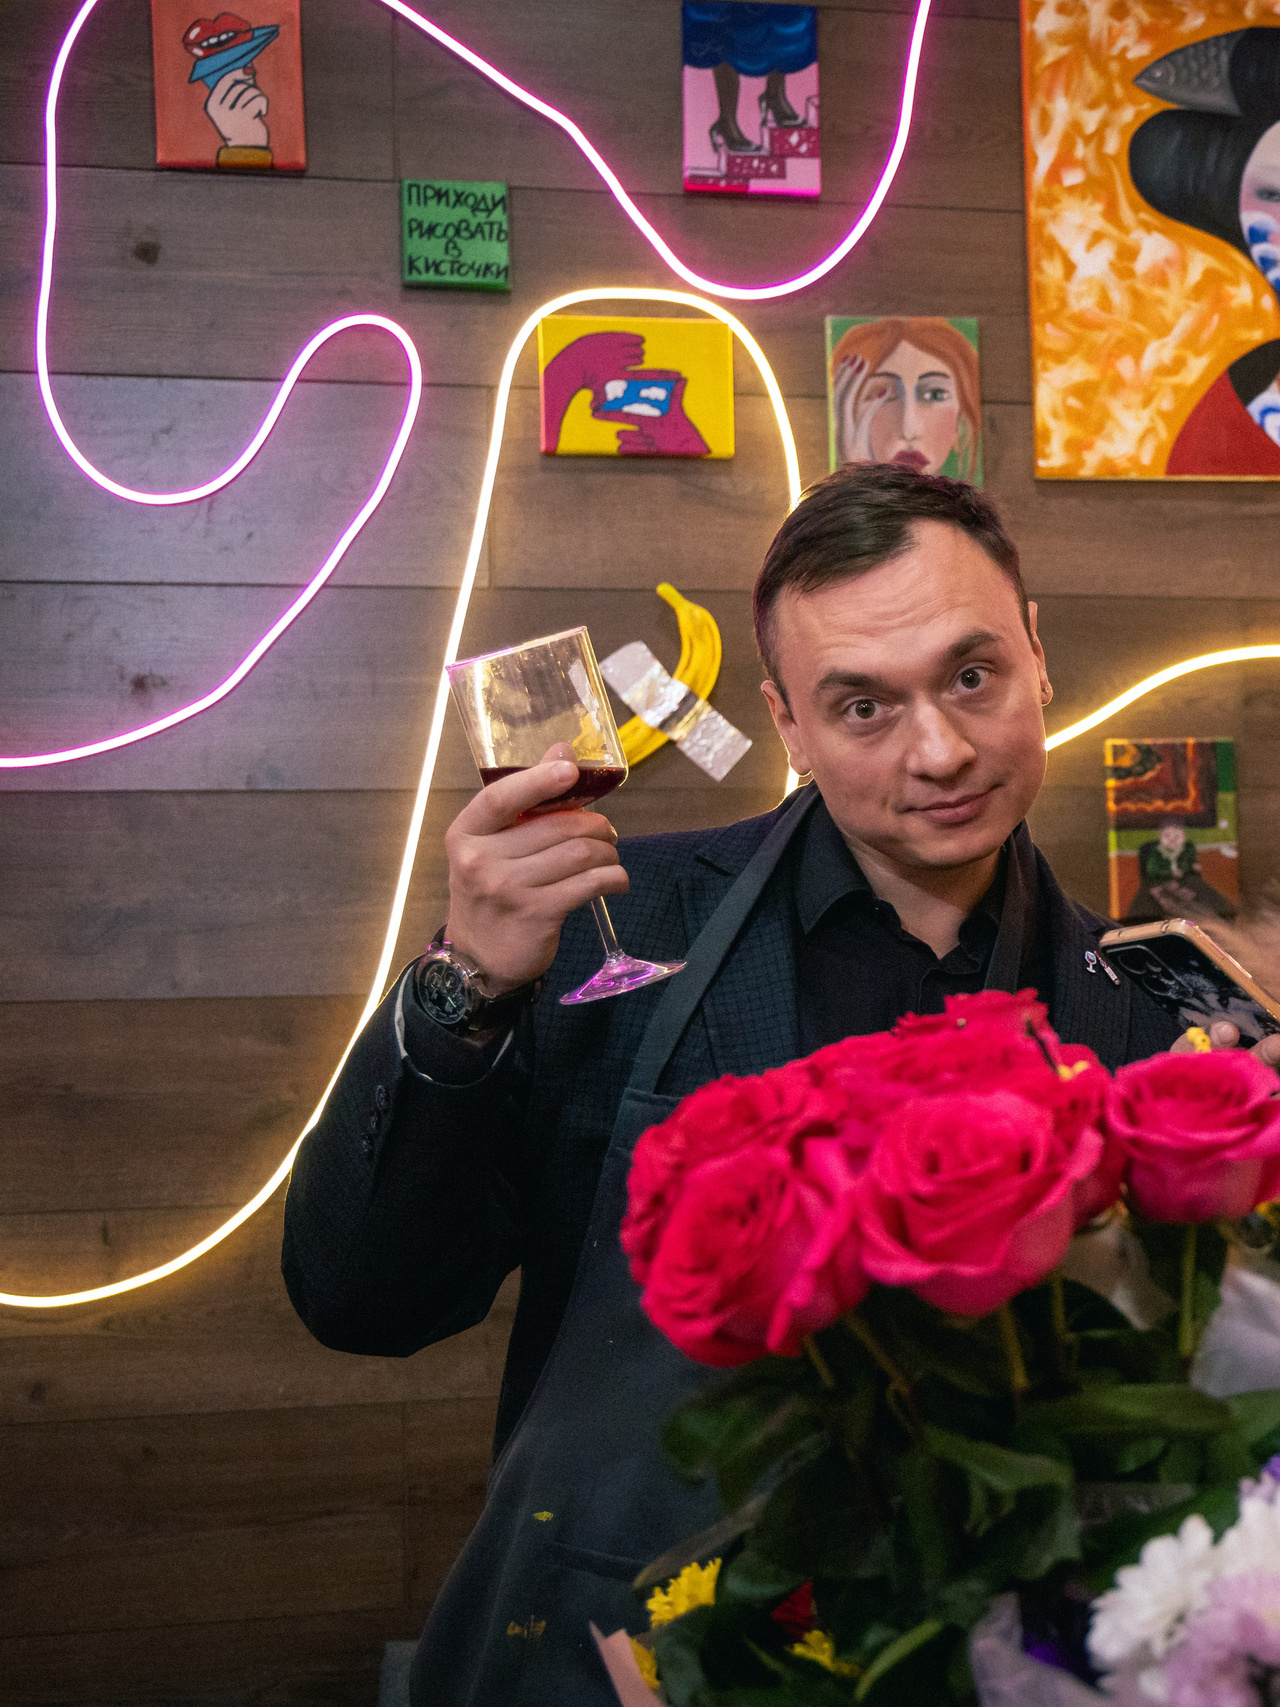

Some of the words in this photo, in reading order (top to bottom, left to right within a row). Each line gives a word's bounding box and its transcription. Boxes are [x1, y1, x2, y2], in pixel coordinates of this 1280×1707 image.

[407, 183, 507, 217] ПРИХОДИ
[408, 218, 508, 242] РИСОВАТЬ
[444, 239, 462, 258] В
[408, 256, 508, 281] КИСТОЧКИ
